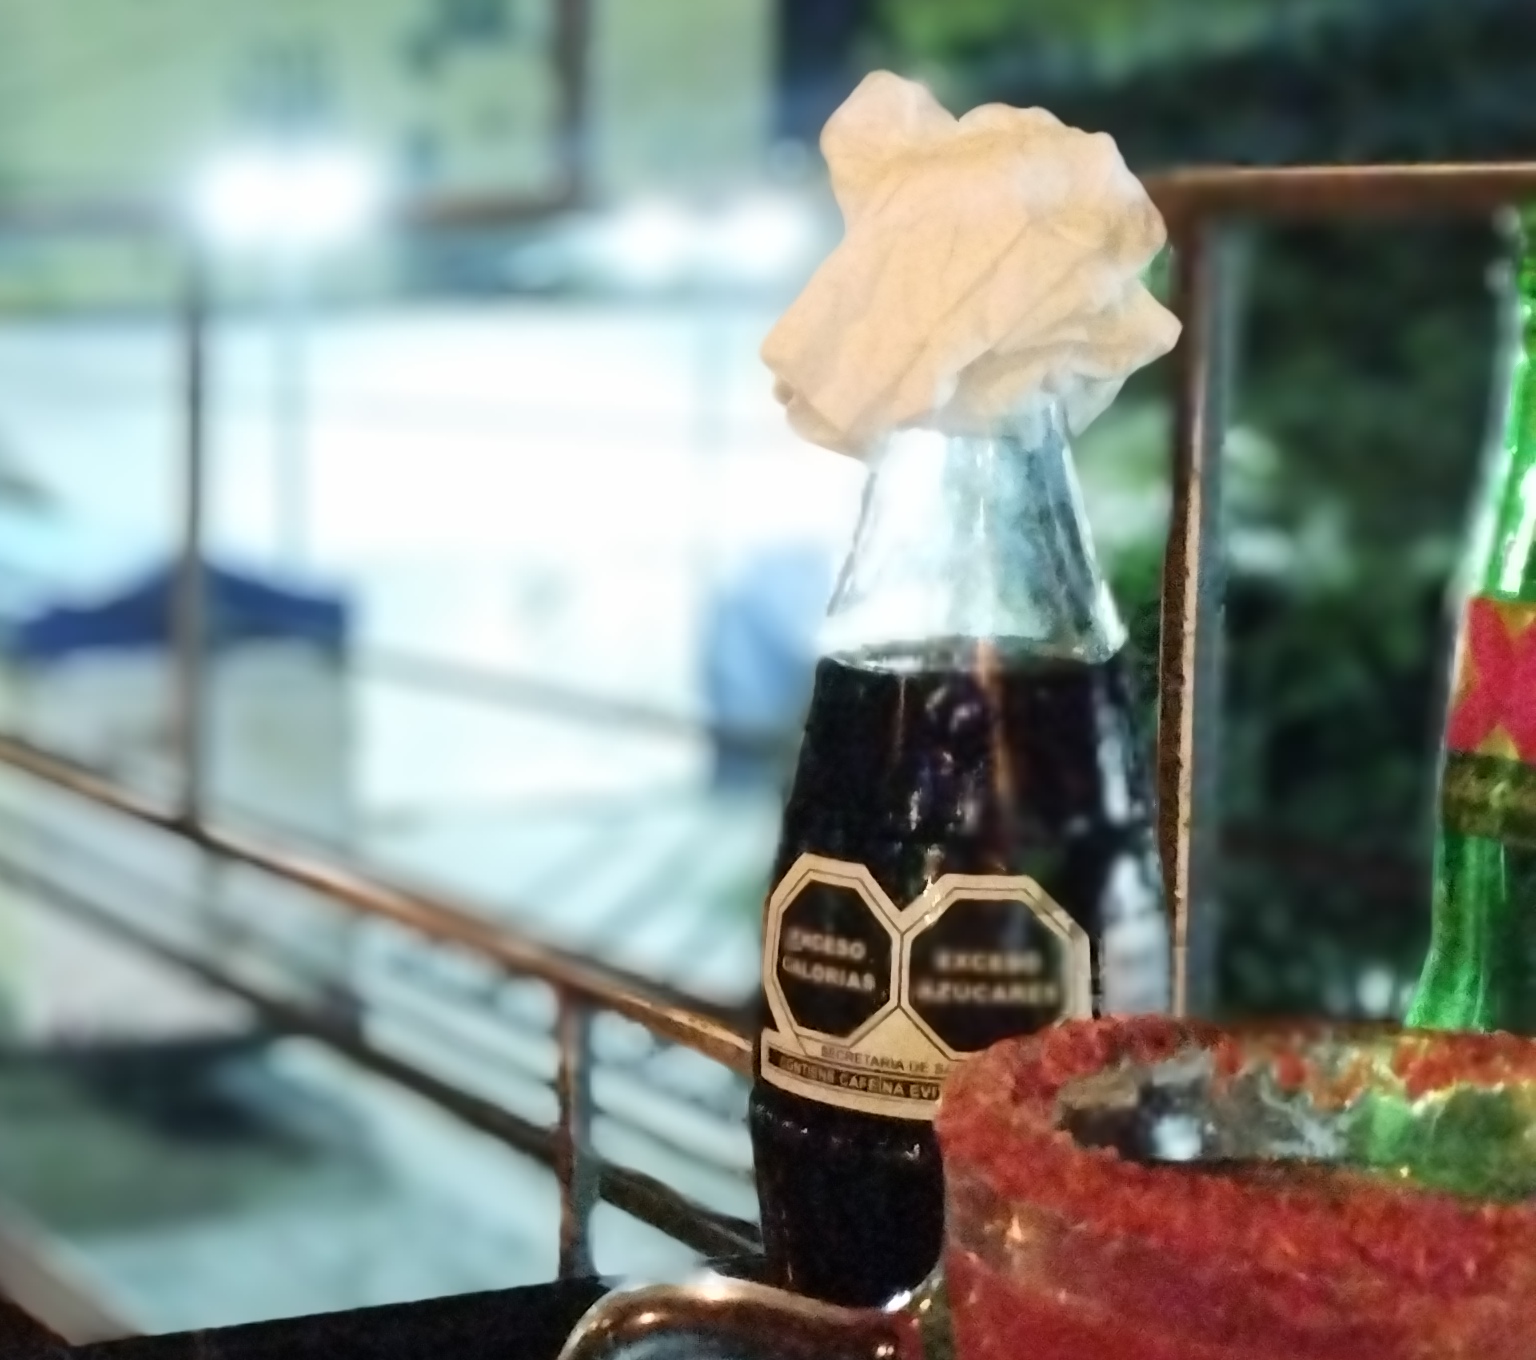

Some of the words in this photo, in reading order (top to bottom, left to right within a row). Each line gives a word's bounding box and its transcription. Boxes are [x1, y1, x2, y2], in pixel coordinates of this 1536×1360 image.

[786, 928, 866, 961] EXCESO
[782, 955, 876, 992] CALORIAS
[933, 950, 1042, 975] EXCESO
[916, 979, 1058, 1005] AZUCARES
[821, 1044, 904, 1071] SECRETARIA
[909, 1083, 939, 1099] EVI
